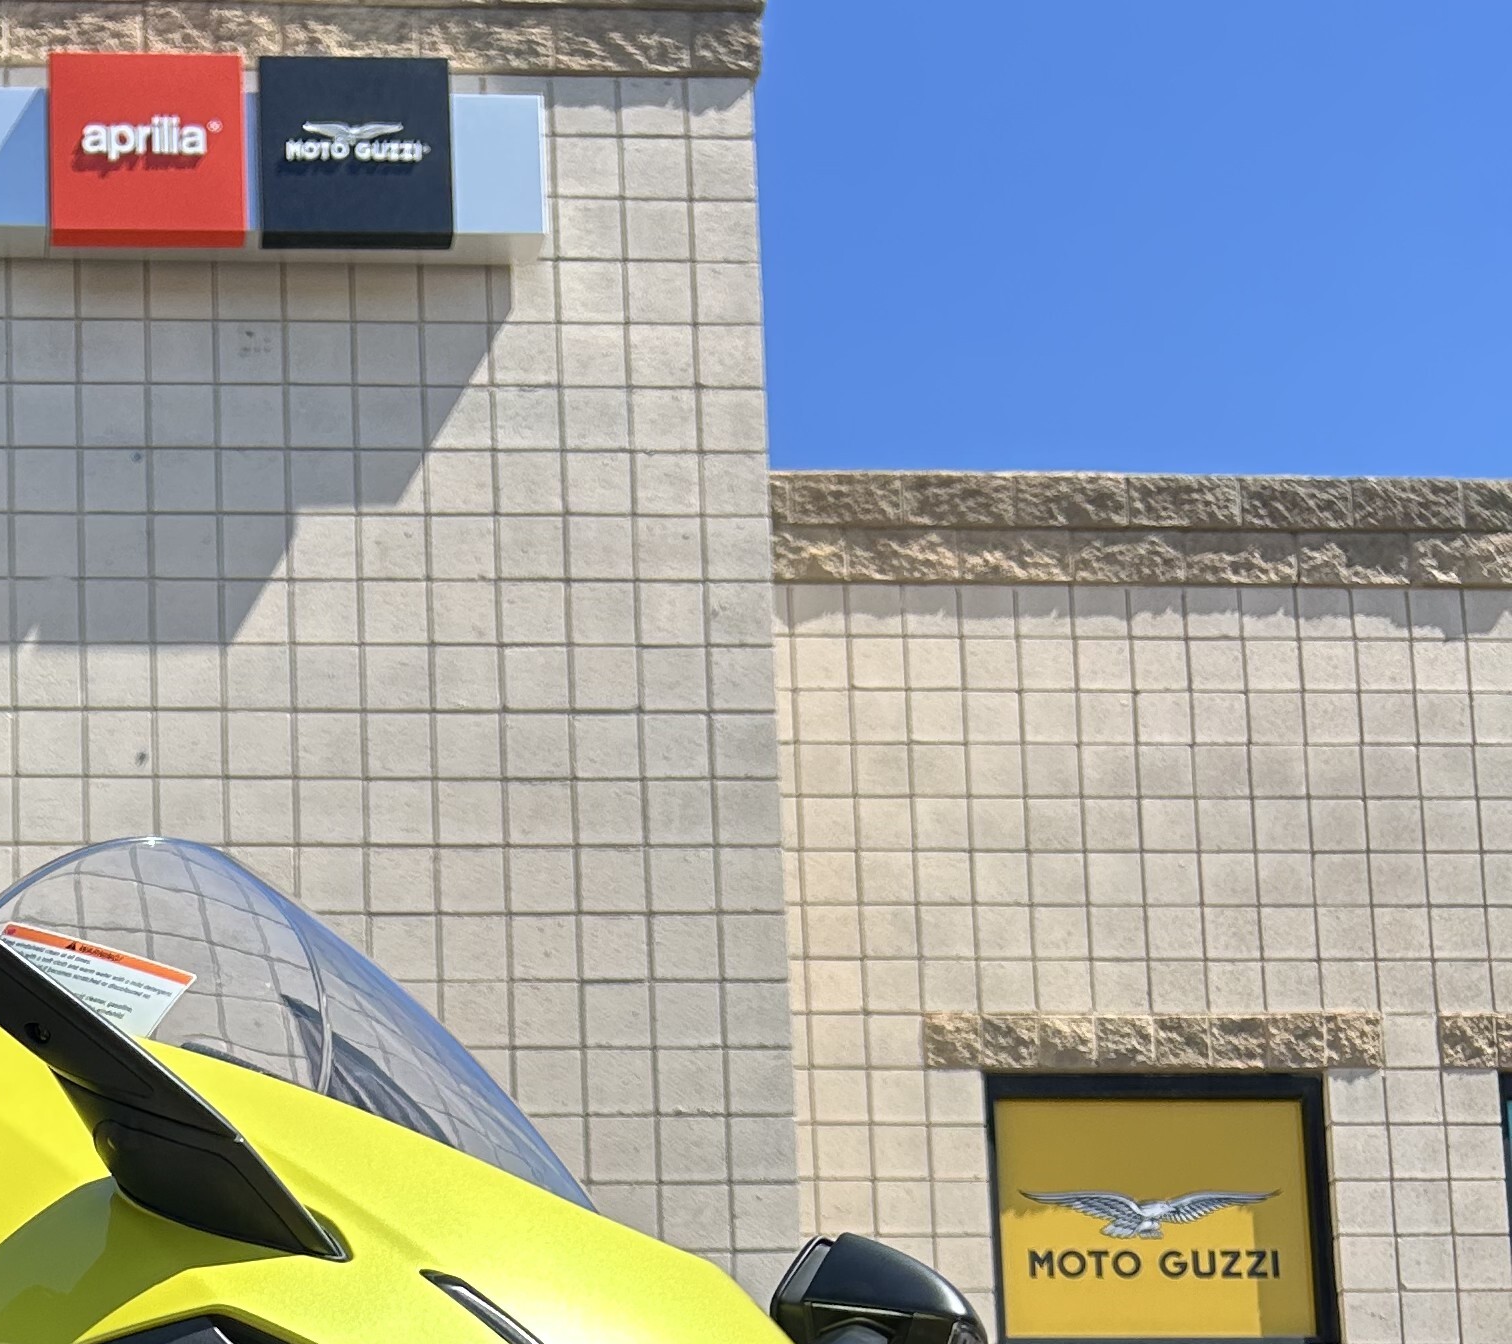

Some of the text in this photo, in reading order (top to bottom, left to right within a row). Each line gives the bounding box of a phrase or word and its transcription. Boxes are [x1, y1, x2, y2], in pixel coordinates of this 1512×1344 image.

[82, 114, 208, 161] aprilia
[286, 139, 424, 163] MOTO GUZZI
[1028, 1248, 1281, 1281] MOTO GUZZI
